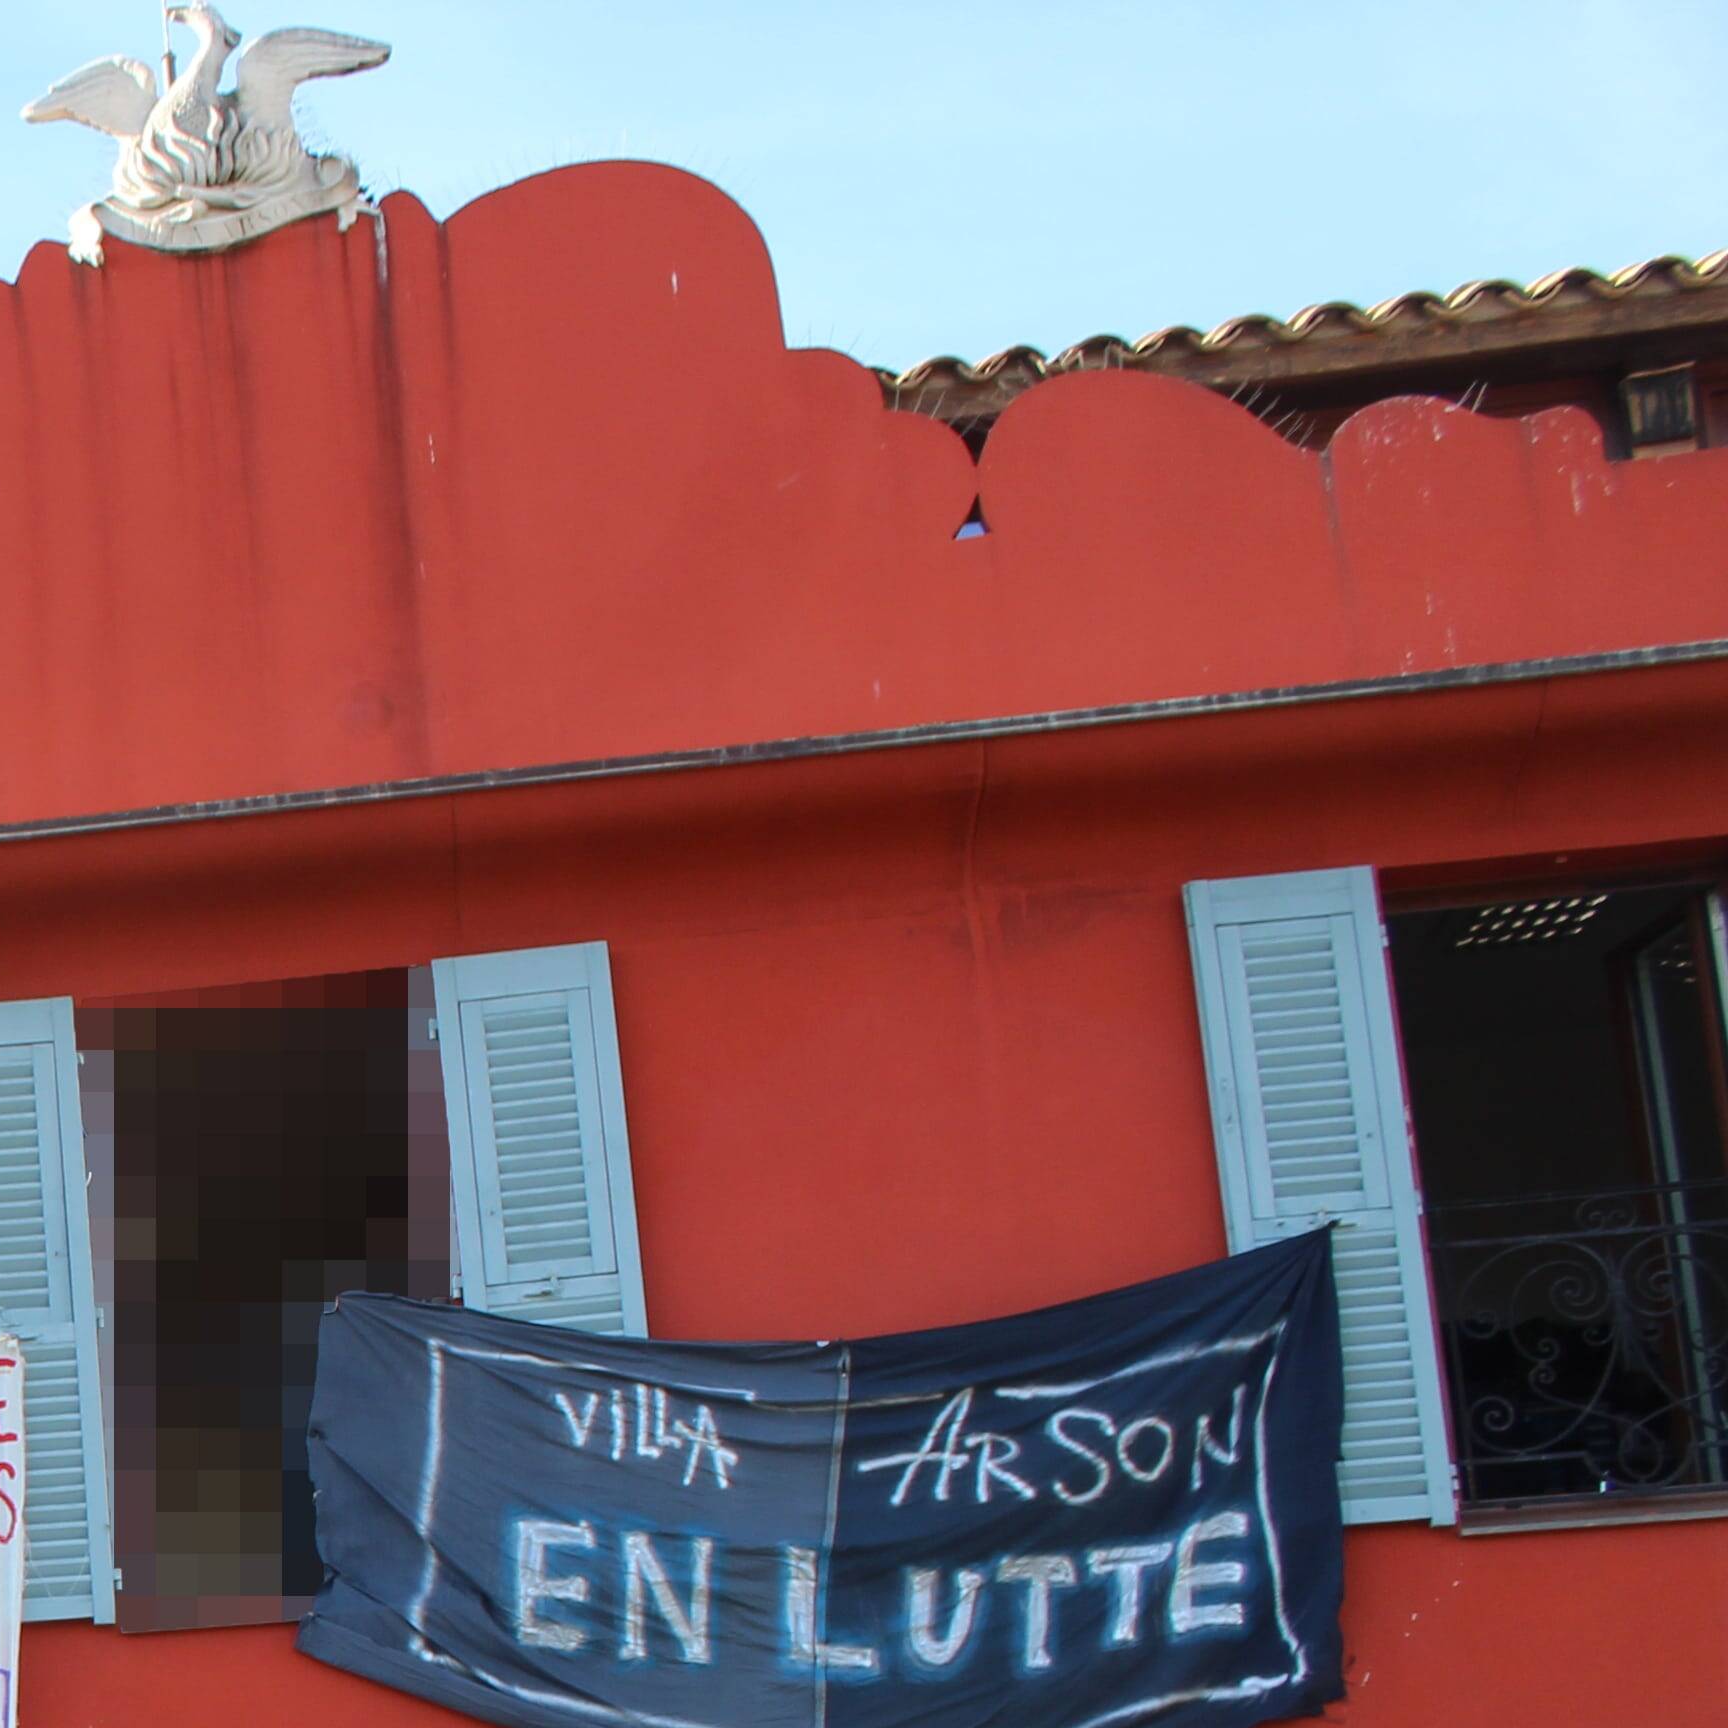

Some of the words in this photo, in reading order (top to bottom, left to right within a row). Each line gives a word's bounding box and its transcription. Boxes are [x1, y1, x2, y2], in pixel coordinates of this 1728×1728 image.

[554, 1383, 739, 1489] VILLA
[857, 1384, 1246, 1506] ARSON
[516, 1519, 714, 1664] EN
[786, 1510, 1248, 1672] LUTTE
